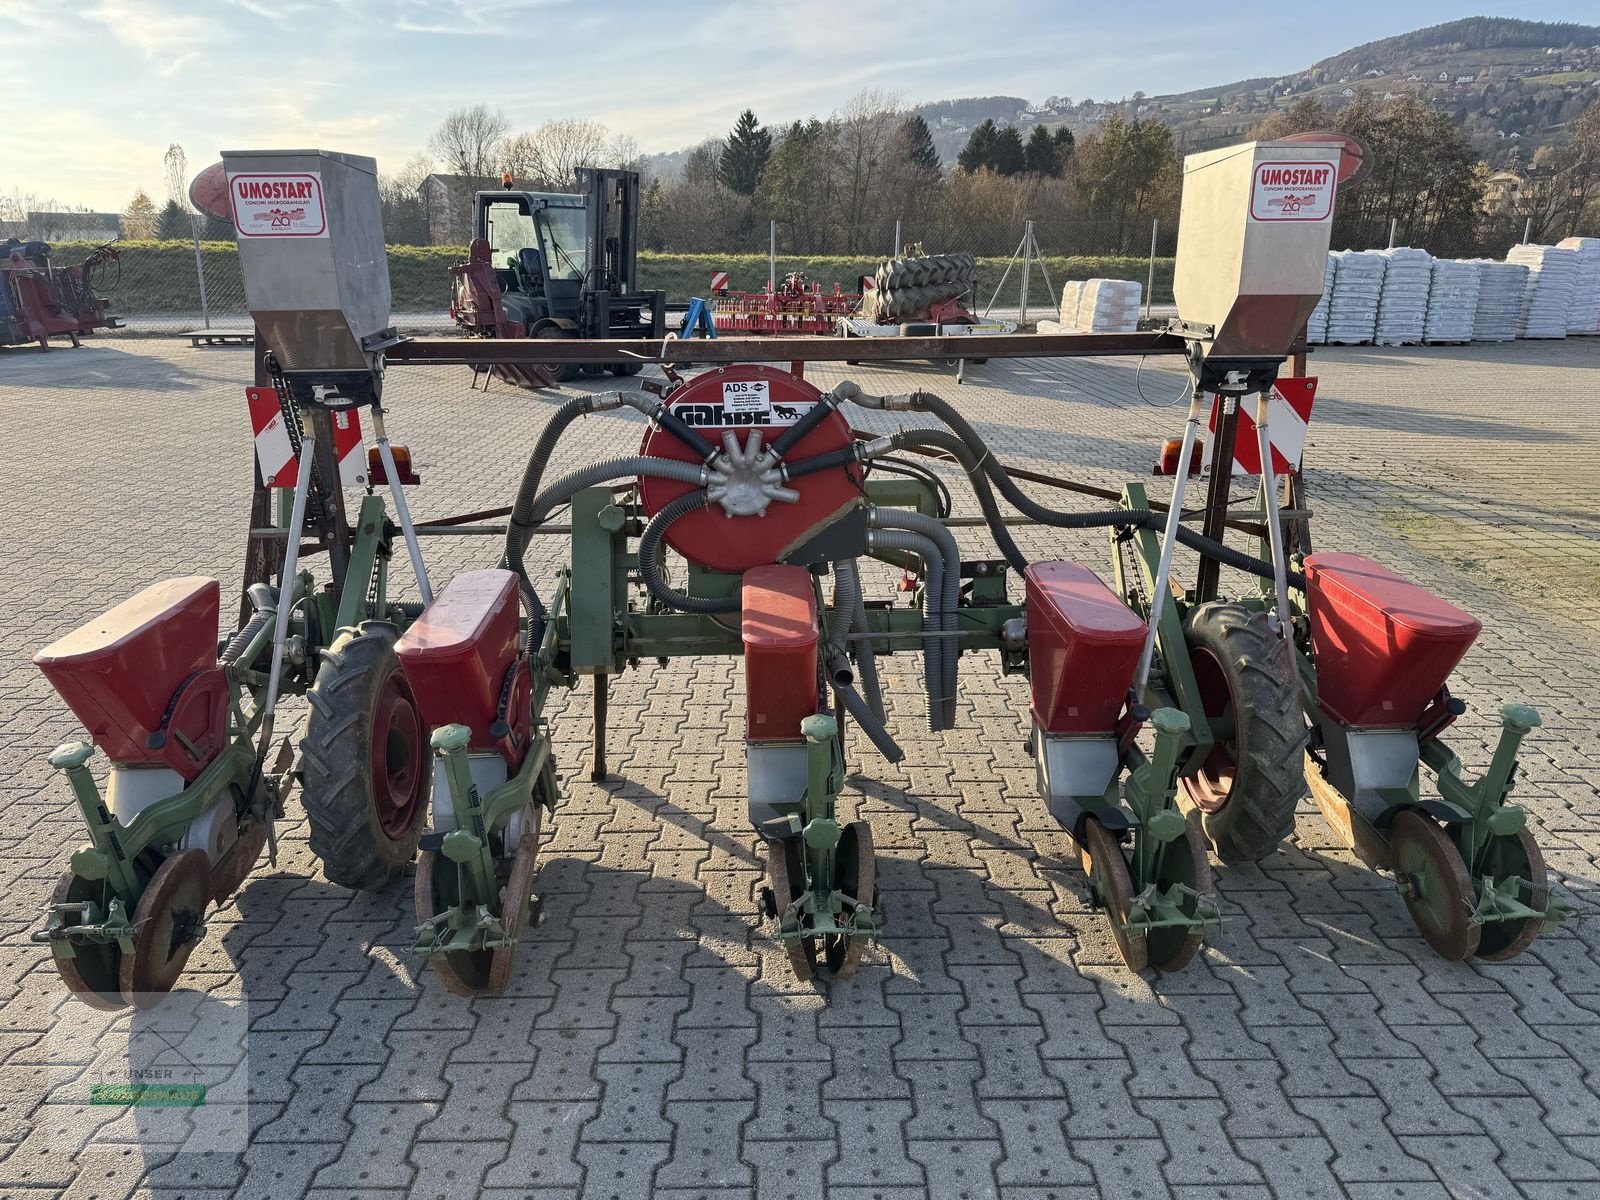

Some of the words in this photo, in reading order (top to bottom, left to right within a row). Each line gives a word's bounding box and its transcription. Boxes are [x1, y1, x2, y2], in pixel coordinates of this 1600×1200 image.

[1261, 169, 1329, 185] UMOSTART
[238, 182, 312, 199] UMOSTART
[725, 383, 748, 393] ADS
